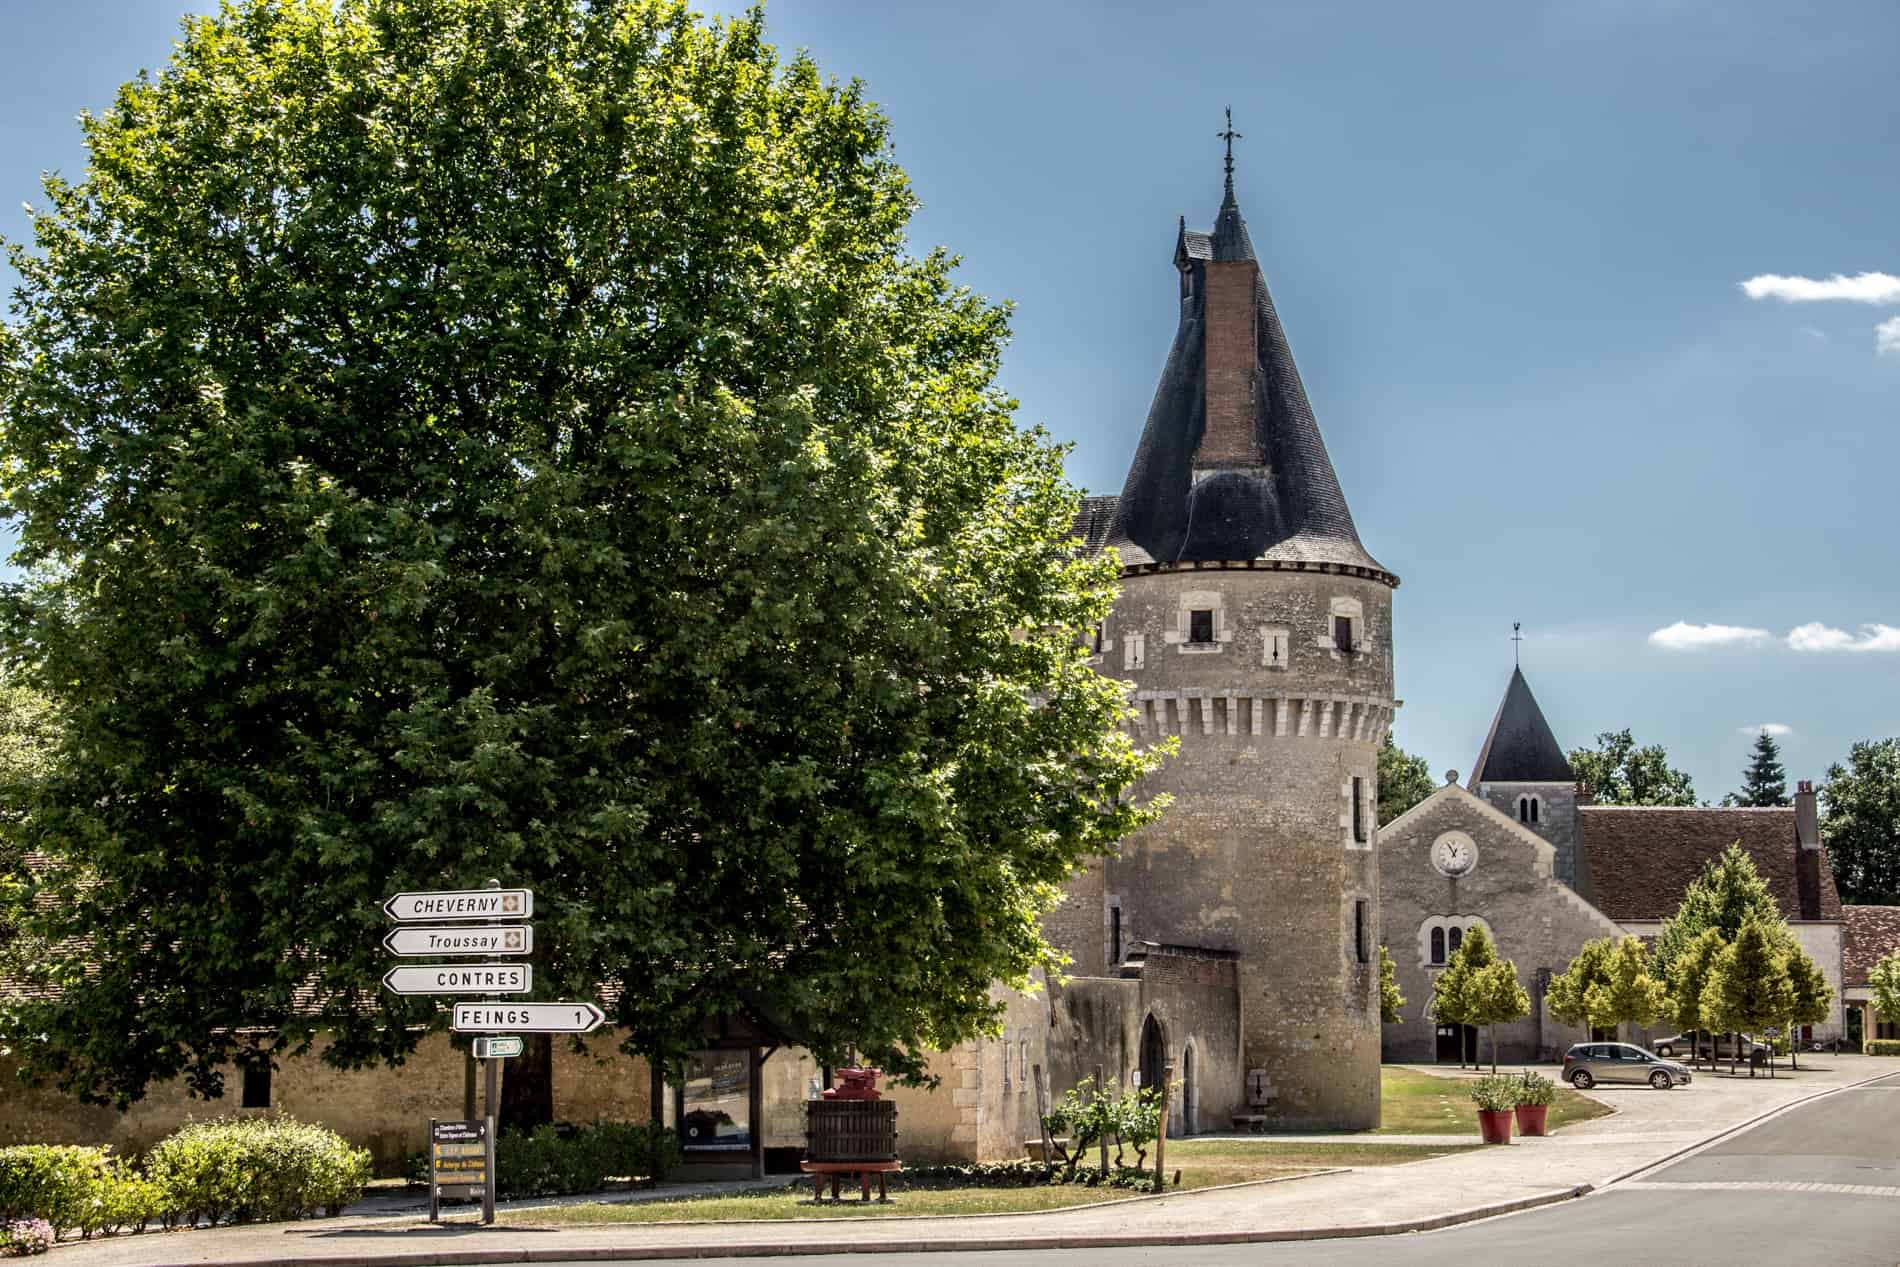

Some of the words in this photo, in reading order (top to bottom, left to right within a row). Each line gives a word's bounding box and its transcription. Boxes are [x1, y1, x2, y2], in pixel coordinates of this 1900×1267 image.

[414, 898, 498, 913] CHEVERNY
[429, 935, 498, 949] Troussay
[437, 972, 519, 985] CONTRES
[461, 1011, 530, 1024] FEINGS
[574, 1012, 582, 1024] 1
